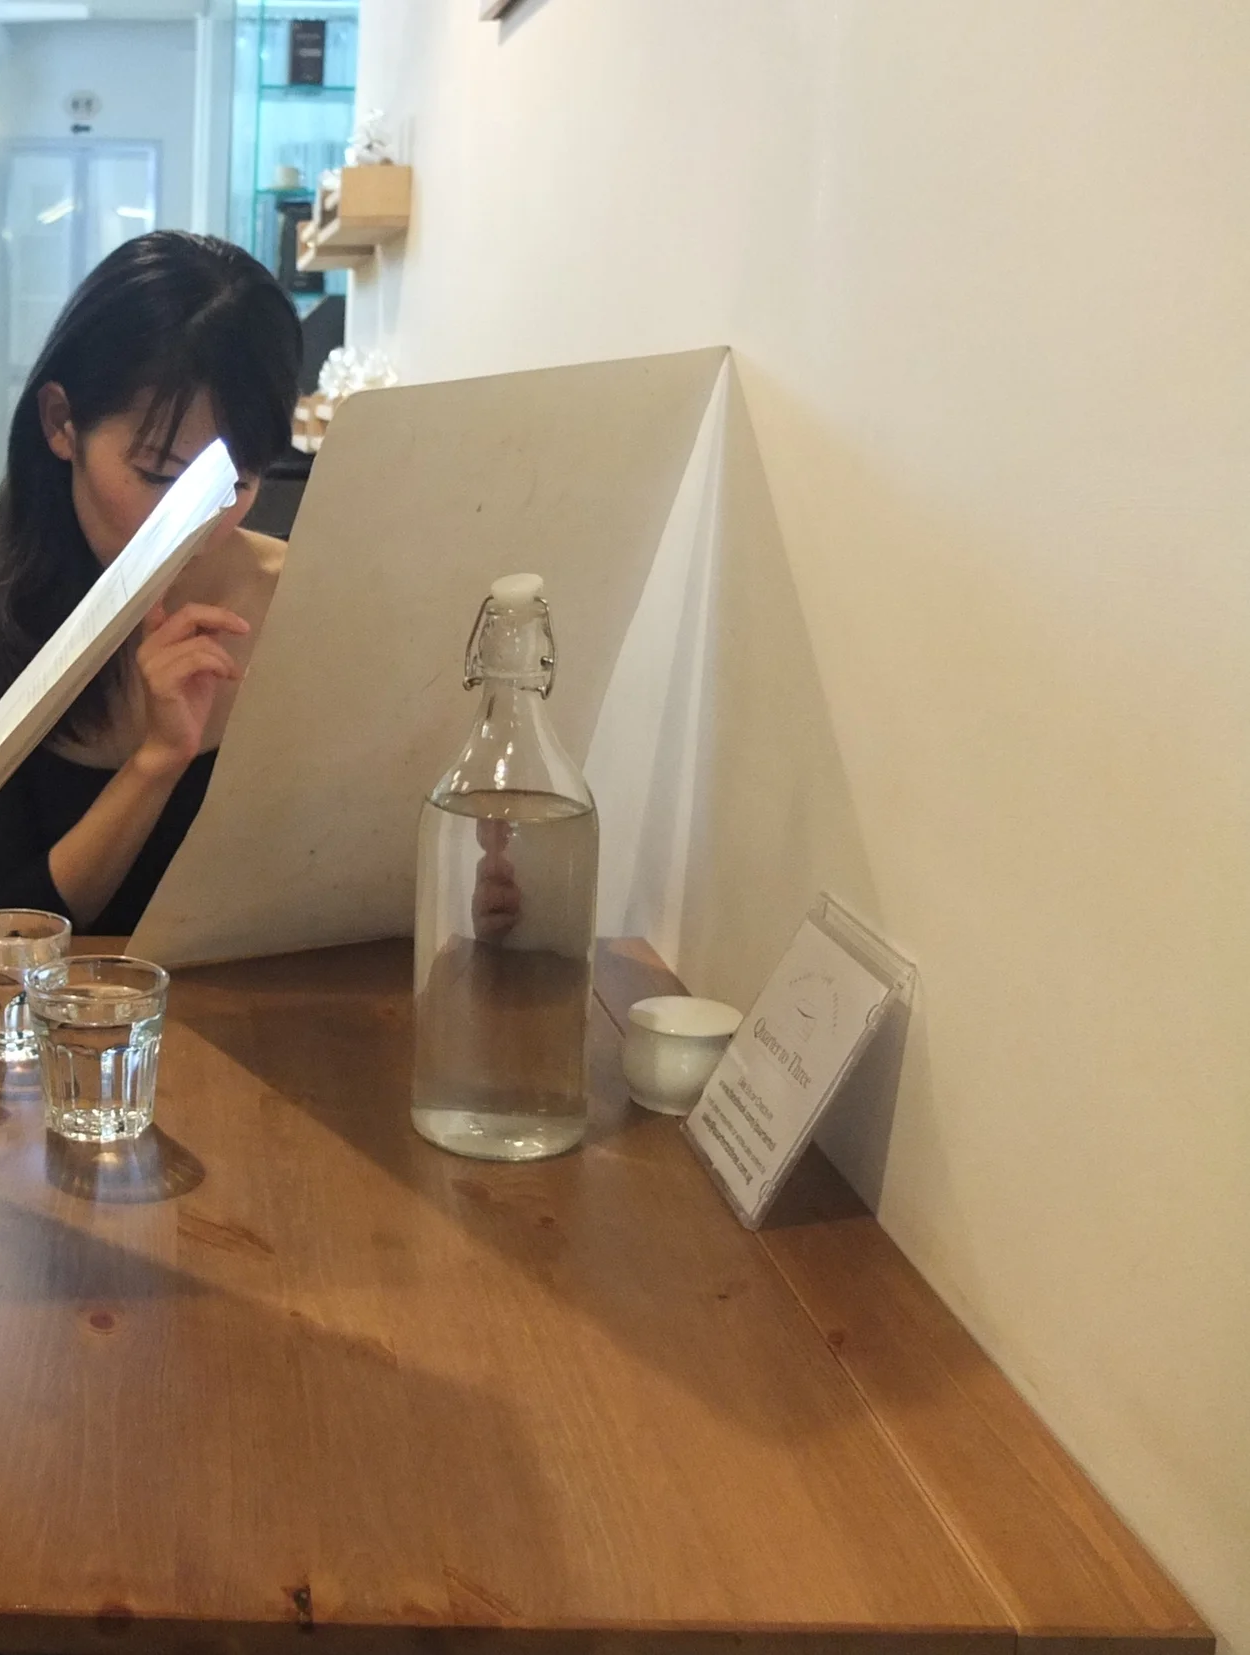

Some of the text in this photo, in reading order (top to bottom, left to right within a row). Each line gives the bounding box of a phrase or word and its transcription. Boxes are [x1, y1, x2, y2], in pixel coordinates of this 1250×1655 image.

[754, 1017, 782, 1056] Quarter
[778, 1049, 789, 1064] to
[788, 1052, 811, 1089] Three
